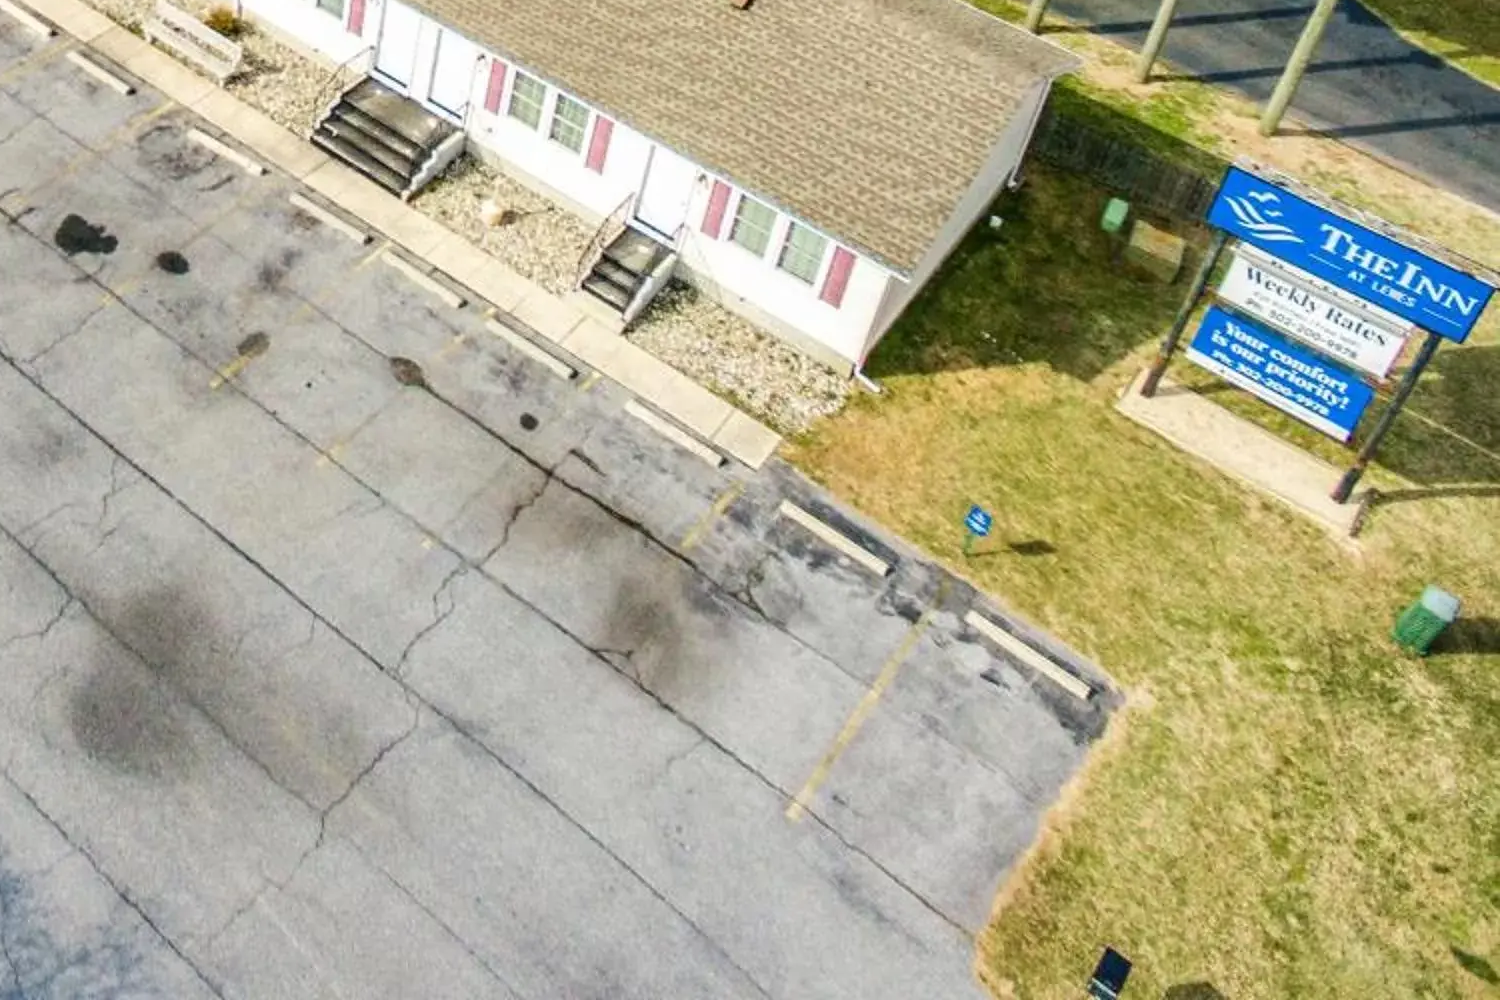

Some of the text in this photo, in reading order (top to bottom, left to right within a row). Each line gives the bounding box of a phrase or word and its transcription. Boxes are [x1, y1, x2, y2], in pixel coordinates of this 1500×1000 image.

[1245, 265, 1317, 313] Weekly
[1325, 306, 1389, 347] Rates
[1319, 222, 1479, 317] THE INN
[1210, 329, 1350, 411] is our priority!
[1225, 320, 1349, 395] Your comfort
